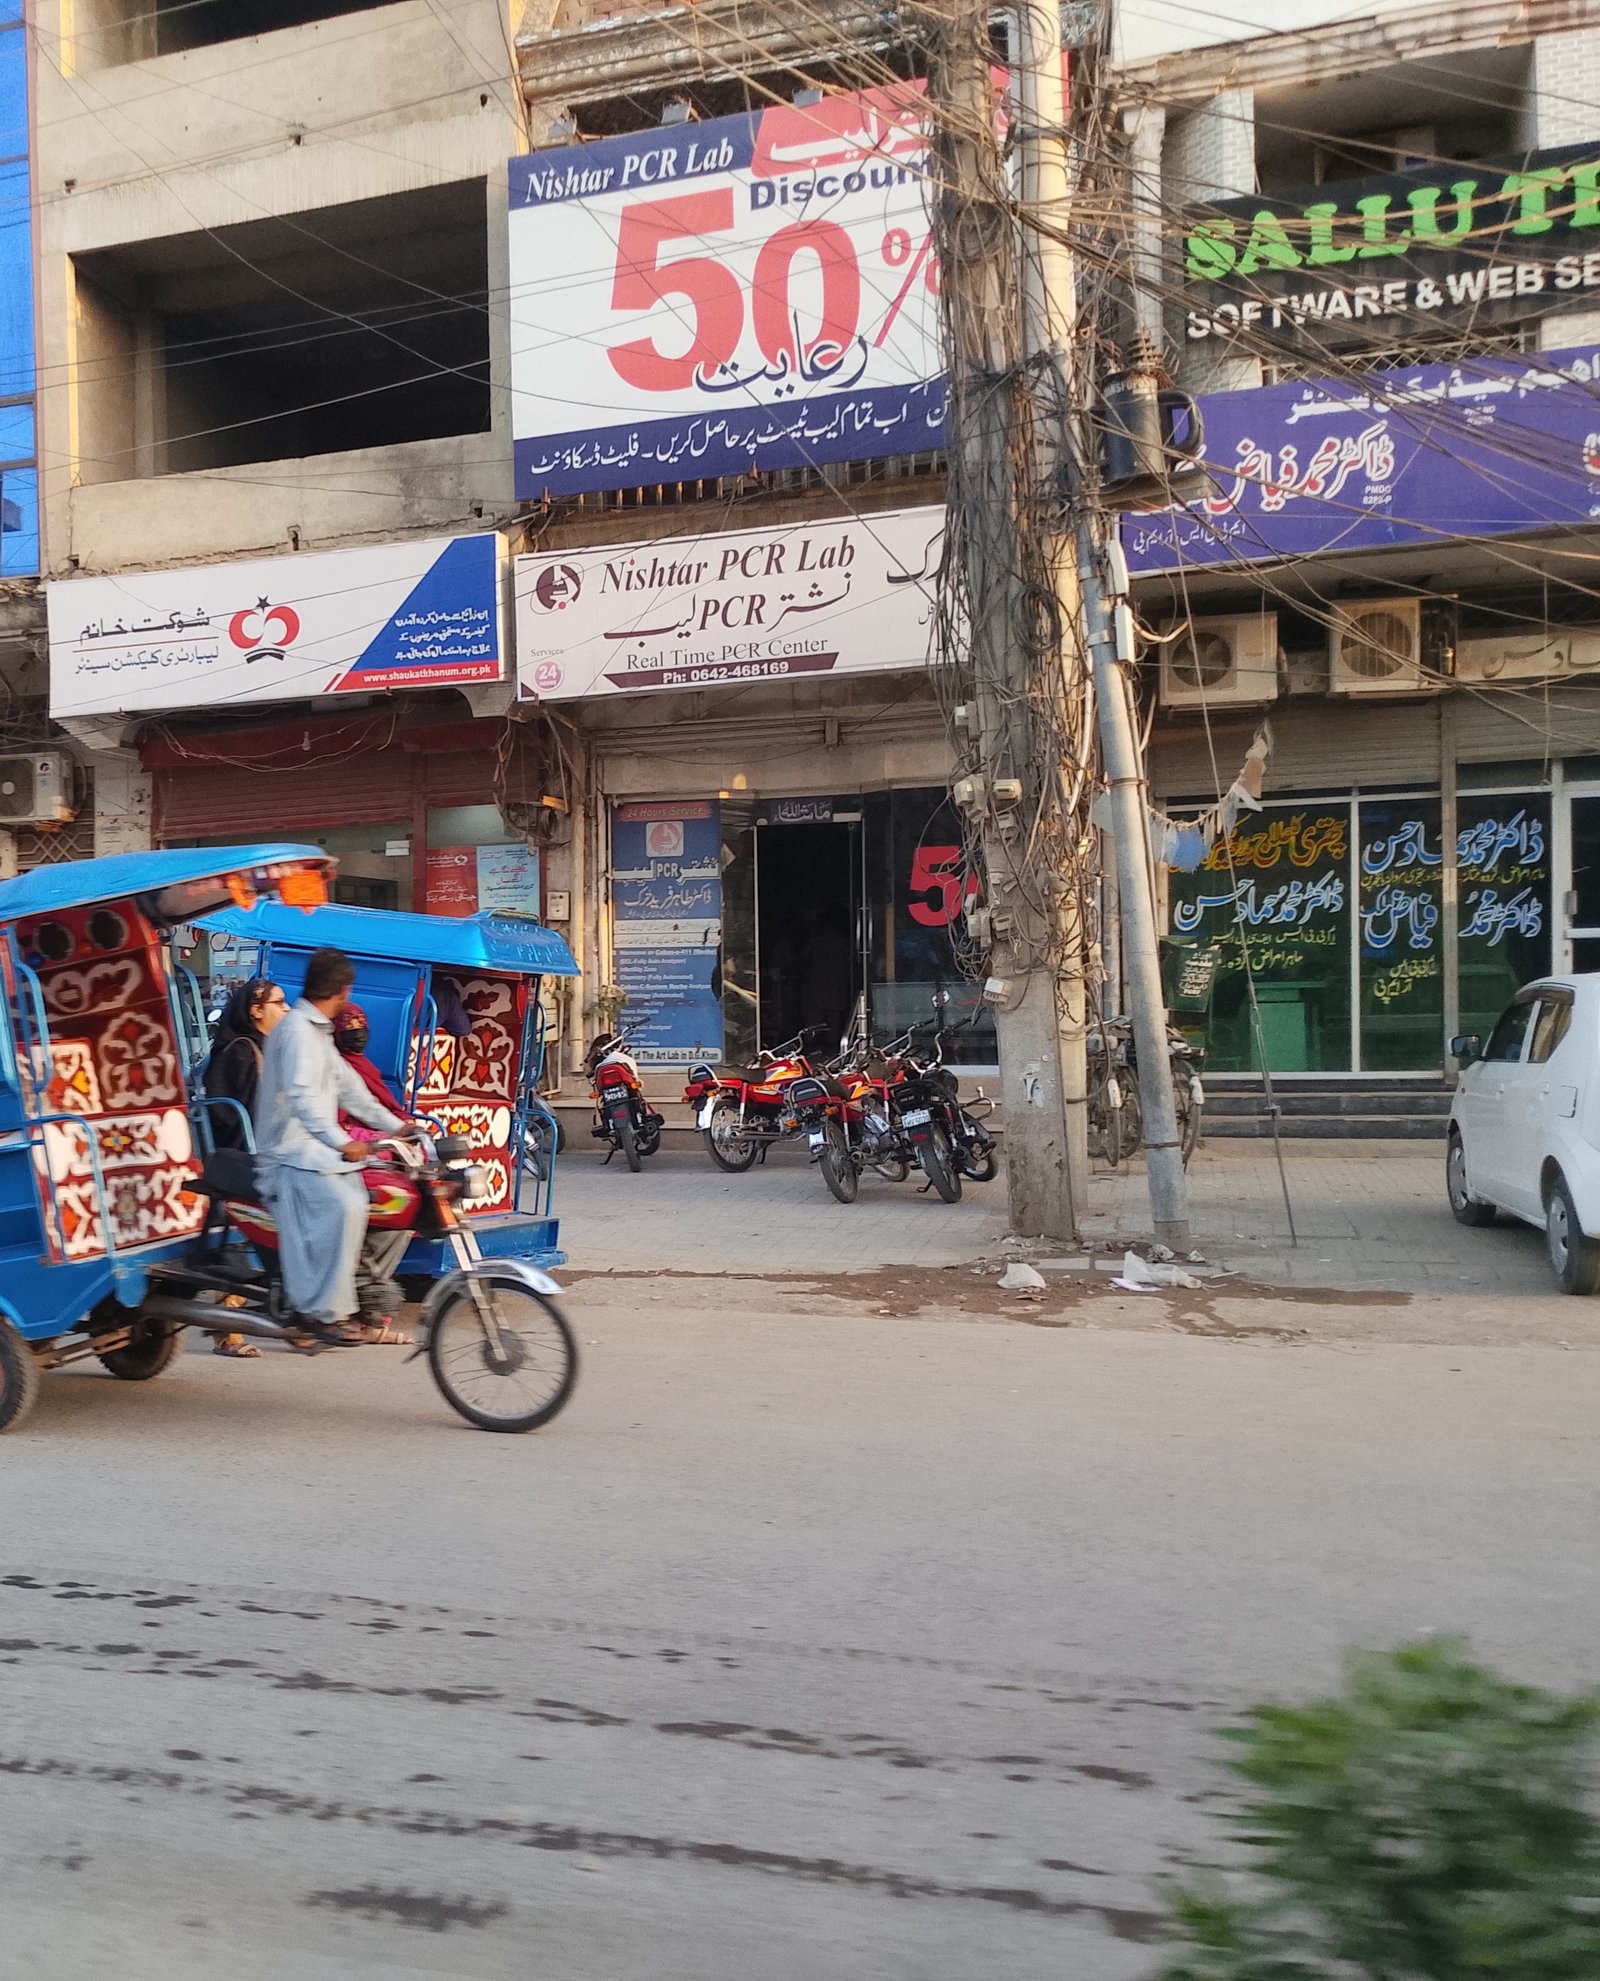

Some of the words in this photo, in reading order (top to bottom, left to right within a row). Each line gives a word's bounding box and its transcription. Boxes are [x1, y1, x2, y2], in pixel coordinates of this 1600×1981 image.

[526, 167, 614, 203] Nishtar
[620, 152, 677, 186] PCR
[684, 138, 734, 170] Lab
[751, 155, 934, 210] Discoun
[1184, 180, 1478, 281] SALLU
[1187, 281, 1407, 338] SOFTWARE
[1415, 277, 1444, 309] &
[1447, 262, 1545, 302] WEB
[692, 309, 868, 397] رعایت
[692, 416, 741, 457] حاصل
[784, 412, 840, 444] لیب
[840, 401, 872, 436] تمام
[872, 402, 908, 434] اب
[601, 431, 641, 467] فلیٹ
[739, 424, 758, 455] پر
[599, 556, 708, 595] Nishtar
[718, 543, 786, 582] PCR
[795, 534, 855, 572] Lab
[131, 607, 209, 634] شوکت
[603, 594, 697, 648] لیب
[697, 593, 767, 632] PCR
[766, 572, 852, 633] نشتر
[80, 617, 131, 646] خانم
[539, 664, 558, 680] 24
[626, 650, 665, 671] Real
[670, 646, 716, 667] Time
[721, 641, 761, 663] PCR
[767, 637, 828, 658] Center
[662, 670, 687, 685] Ph:
[690, 660, 789, 682] 0642-468169
[363, 664, 491, 684] www.shaukatkhanum.org.pk
[1483, 808, 1544, 873] ڈاکٹر
[657, 862, 679, 878] PCR
[1173, 877, 1257, 931] حسن
[1298, 869, 1346, 925] ڈاکٹر
[1487, 886, 1544, 948] ڈاکٹر
[642, 1051, 655, 1060] The
[656, 1051, 666, 1060] Art
